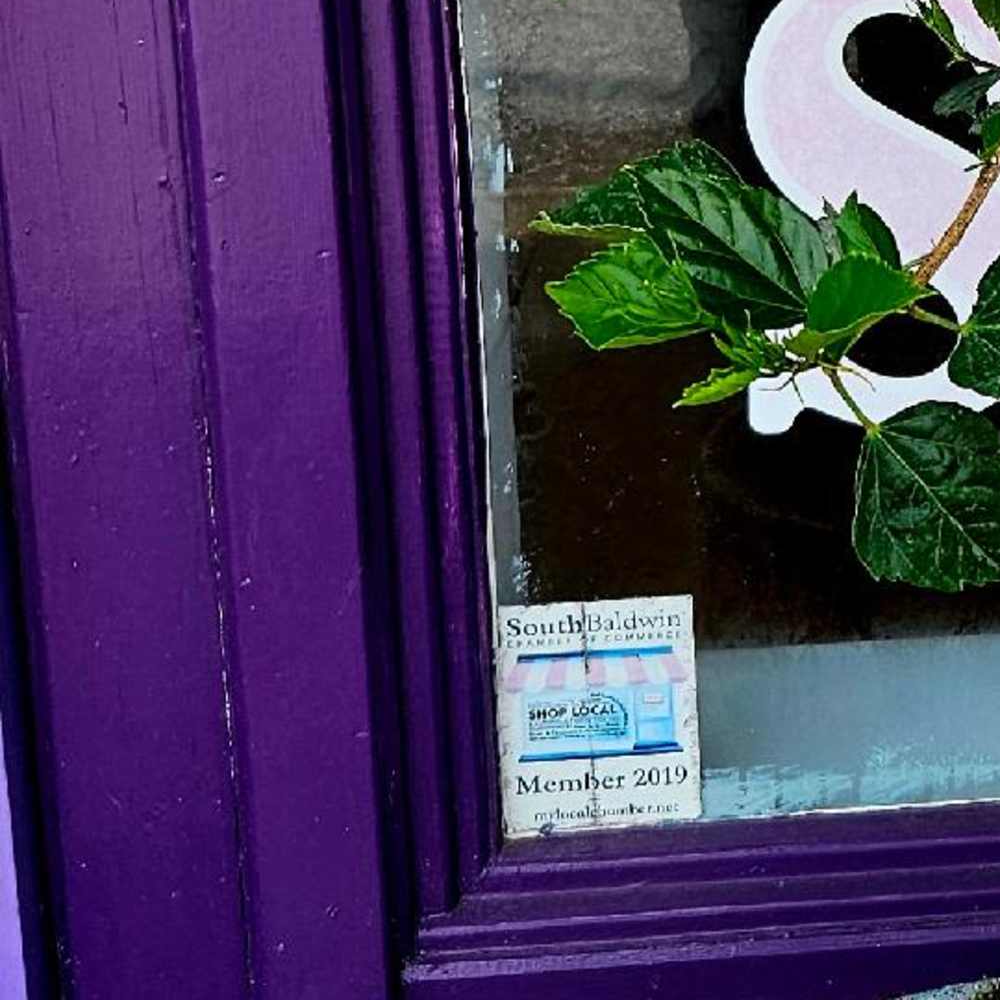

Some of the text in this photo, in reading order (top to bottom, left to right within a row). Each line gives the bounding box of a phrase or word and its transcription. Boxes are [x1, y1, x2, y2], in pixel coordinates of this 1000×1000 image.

[529, 704, 617, 720] SHOP LOCAL
[516, 765, 688, 795] Member 2019
